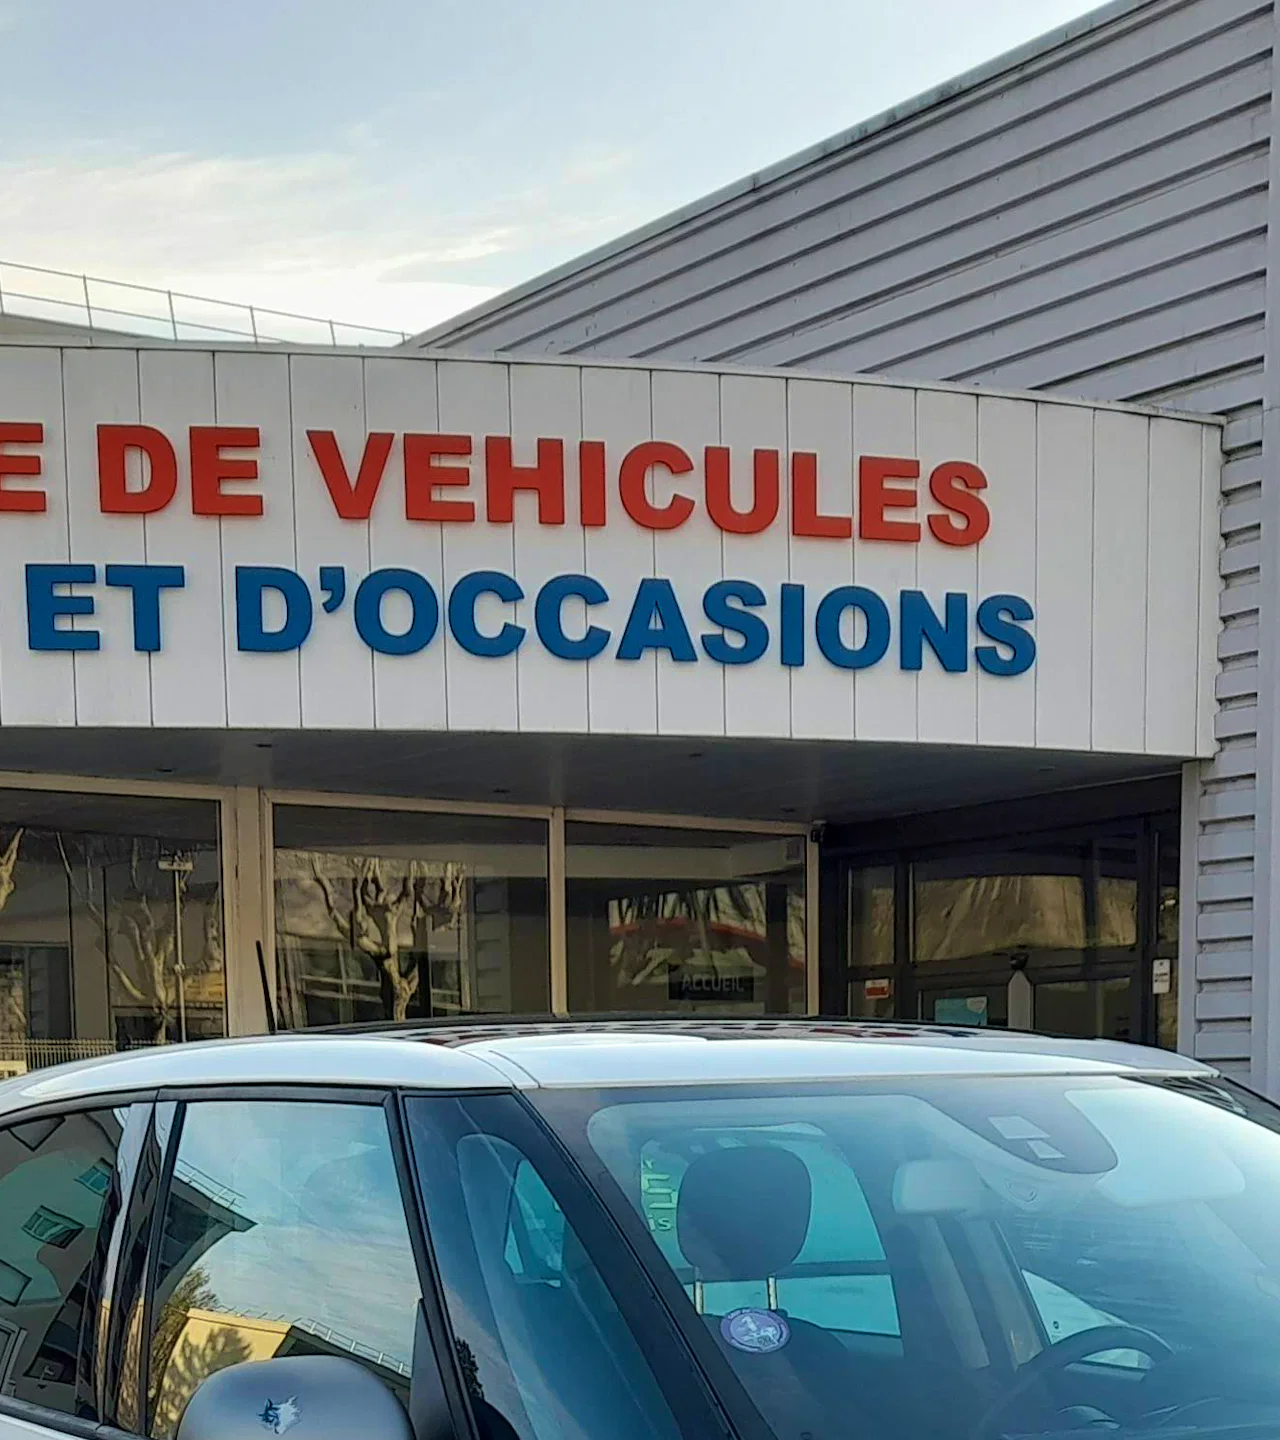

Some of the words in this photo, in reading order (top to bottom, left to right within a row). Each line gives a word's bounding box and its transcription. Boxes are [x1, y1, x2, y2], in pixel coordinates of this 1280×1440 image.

[96, 424, 264, 516] DE
[307, 429, 991, 546] VEHICULES
[25, 563, 186, 652] ET
[235, 564, 1037, 677] D'OCCASIONS
[680, 972, 745, 992] ACCUEIL
